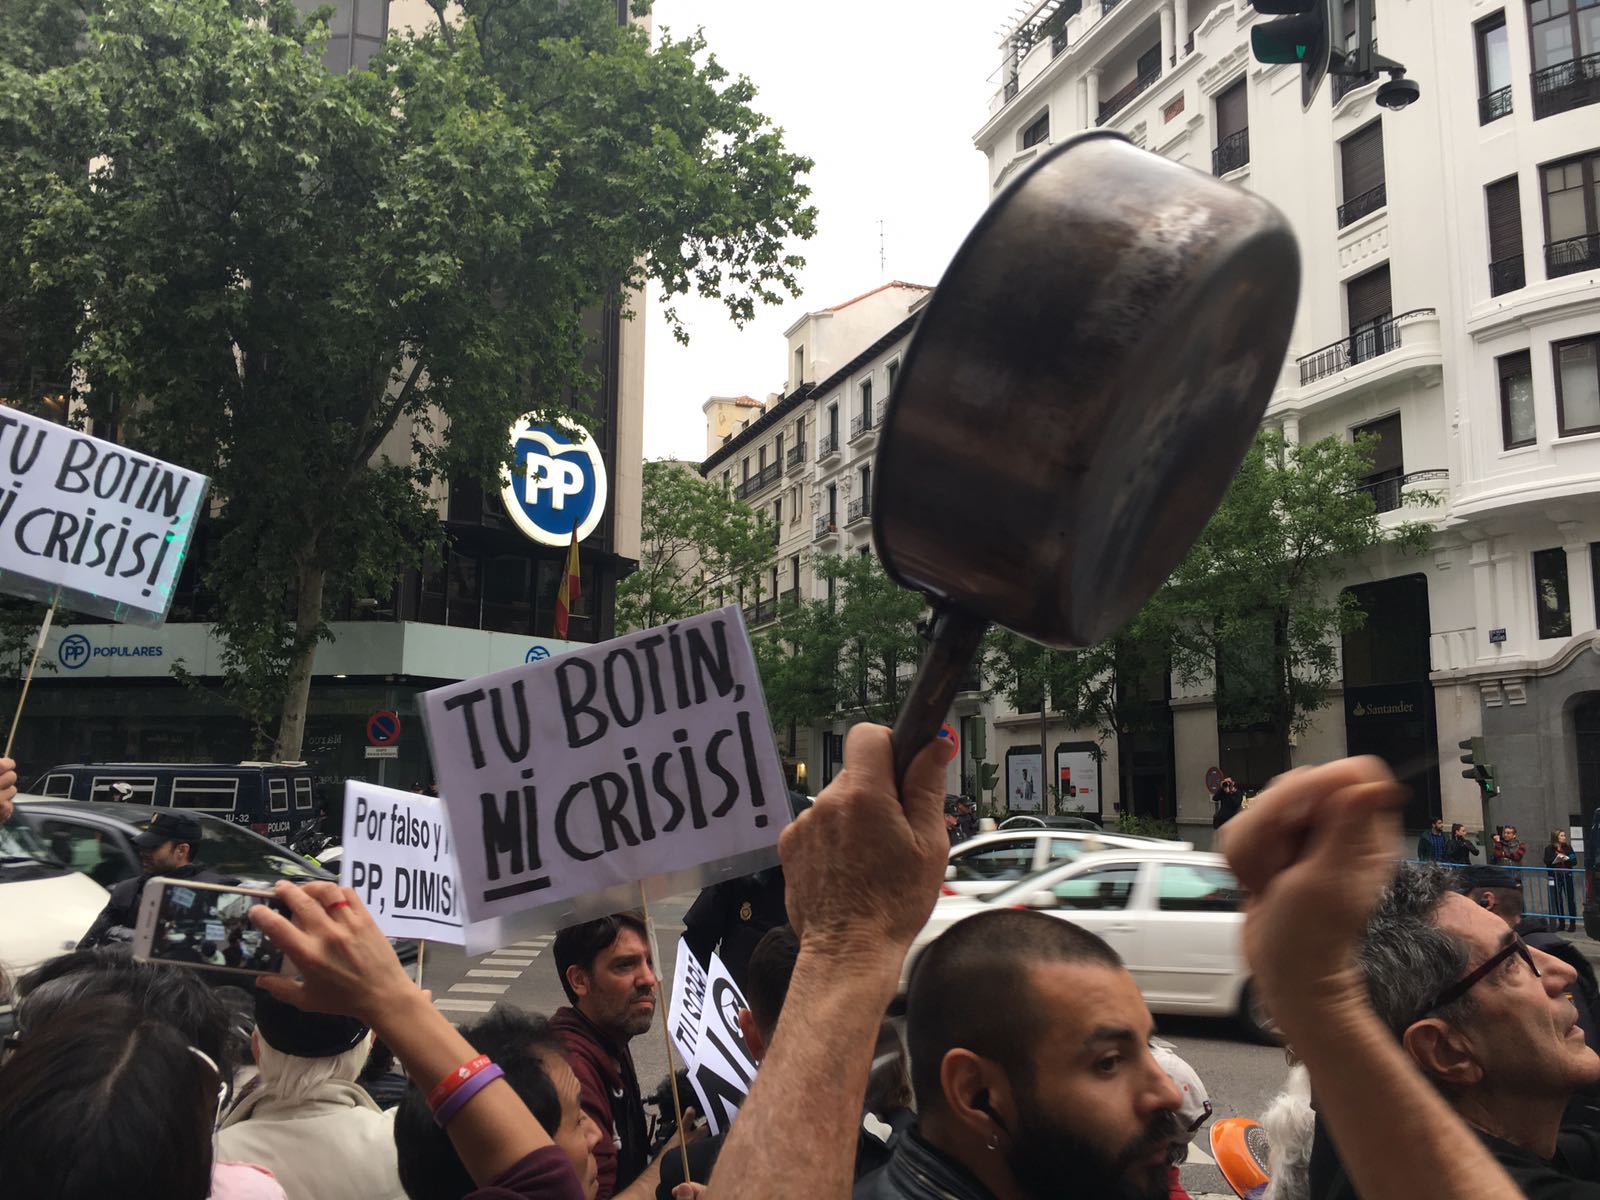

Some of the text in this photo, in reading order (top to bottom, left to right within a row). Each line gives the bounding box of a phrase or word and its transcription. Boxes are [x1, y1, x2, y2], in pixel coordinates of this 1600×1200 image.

[524, 451, 585, 511] PP
[65, 645, 163, 661] PP POPULARES
[443, 619, 746, 770] TU BOTÍN,
[1366, 700, 1414, 715] Santander
[267, 821, 290, 833] POLICIA
[353, 796, 387, 842] Por
[390, 803, 430, 850] falso
[433, 823, 442, 862] y
[351, 860, 386, 914] PP,
